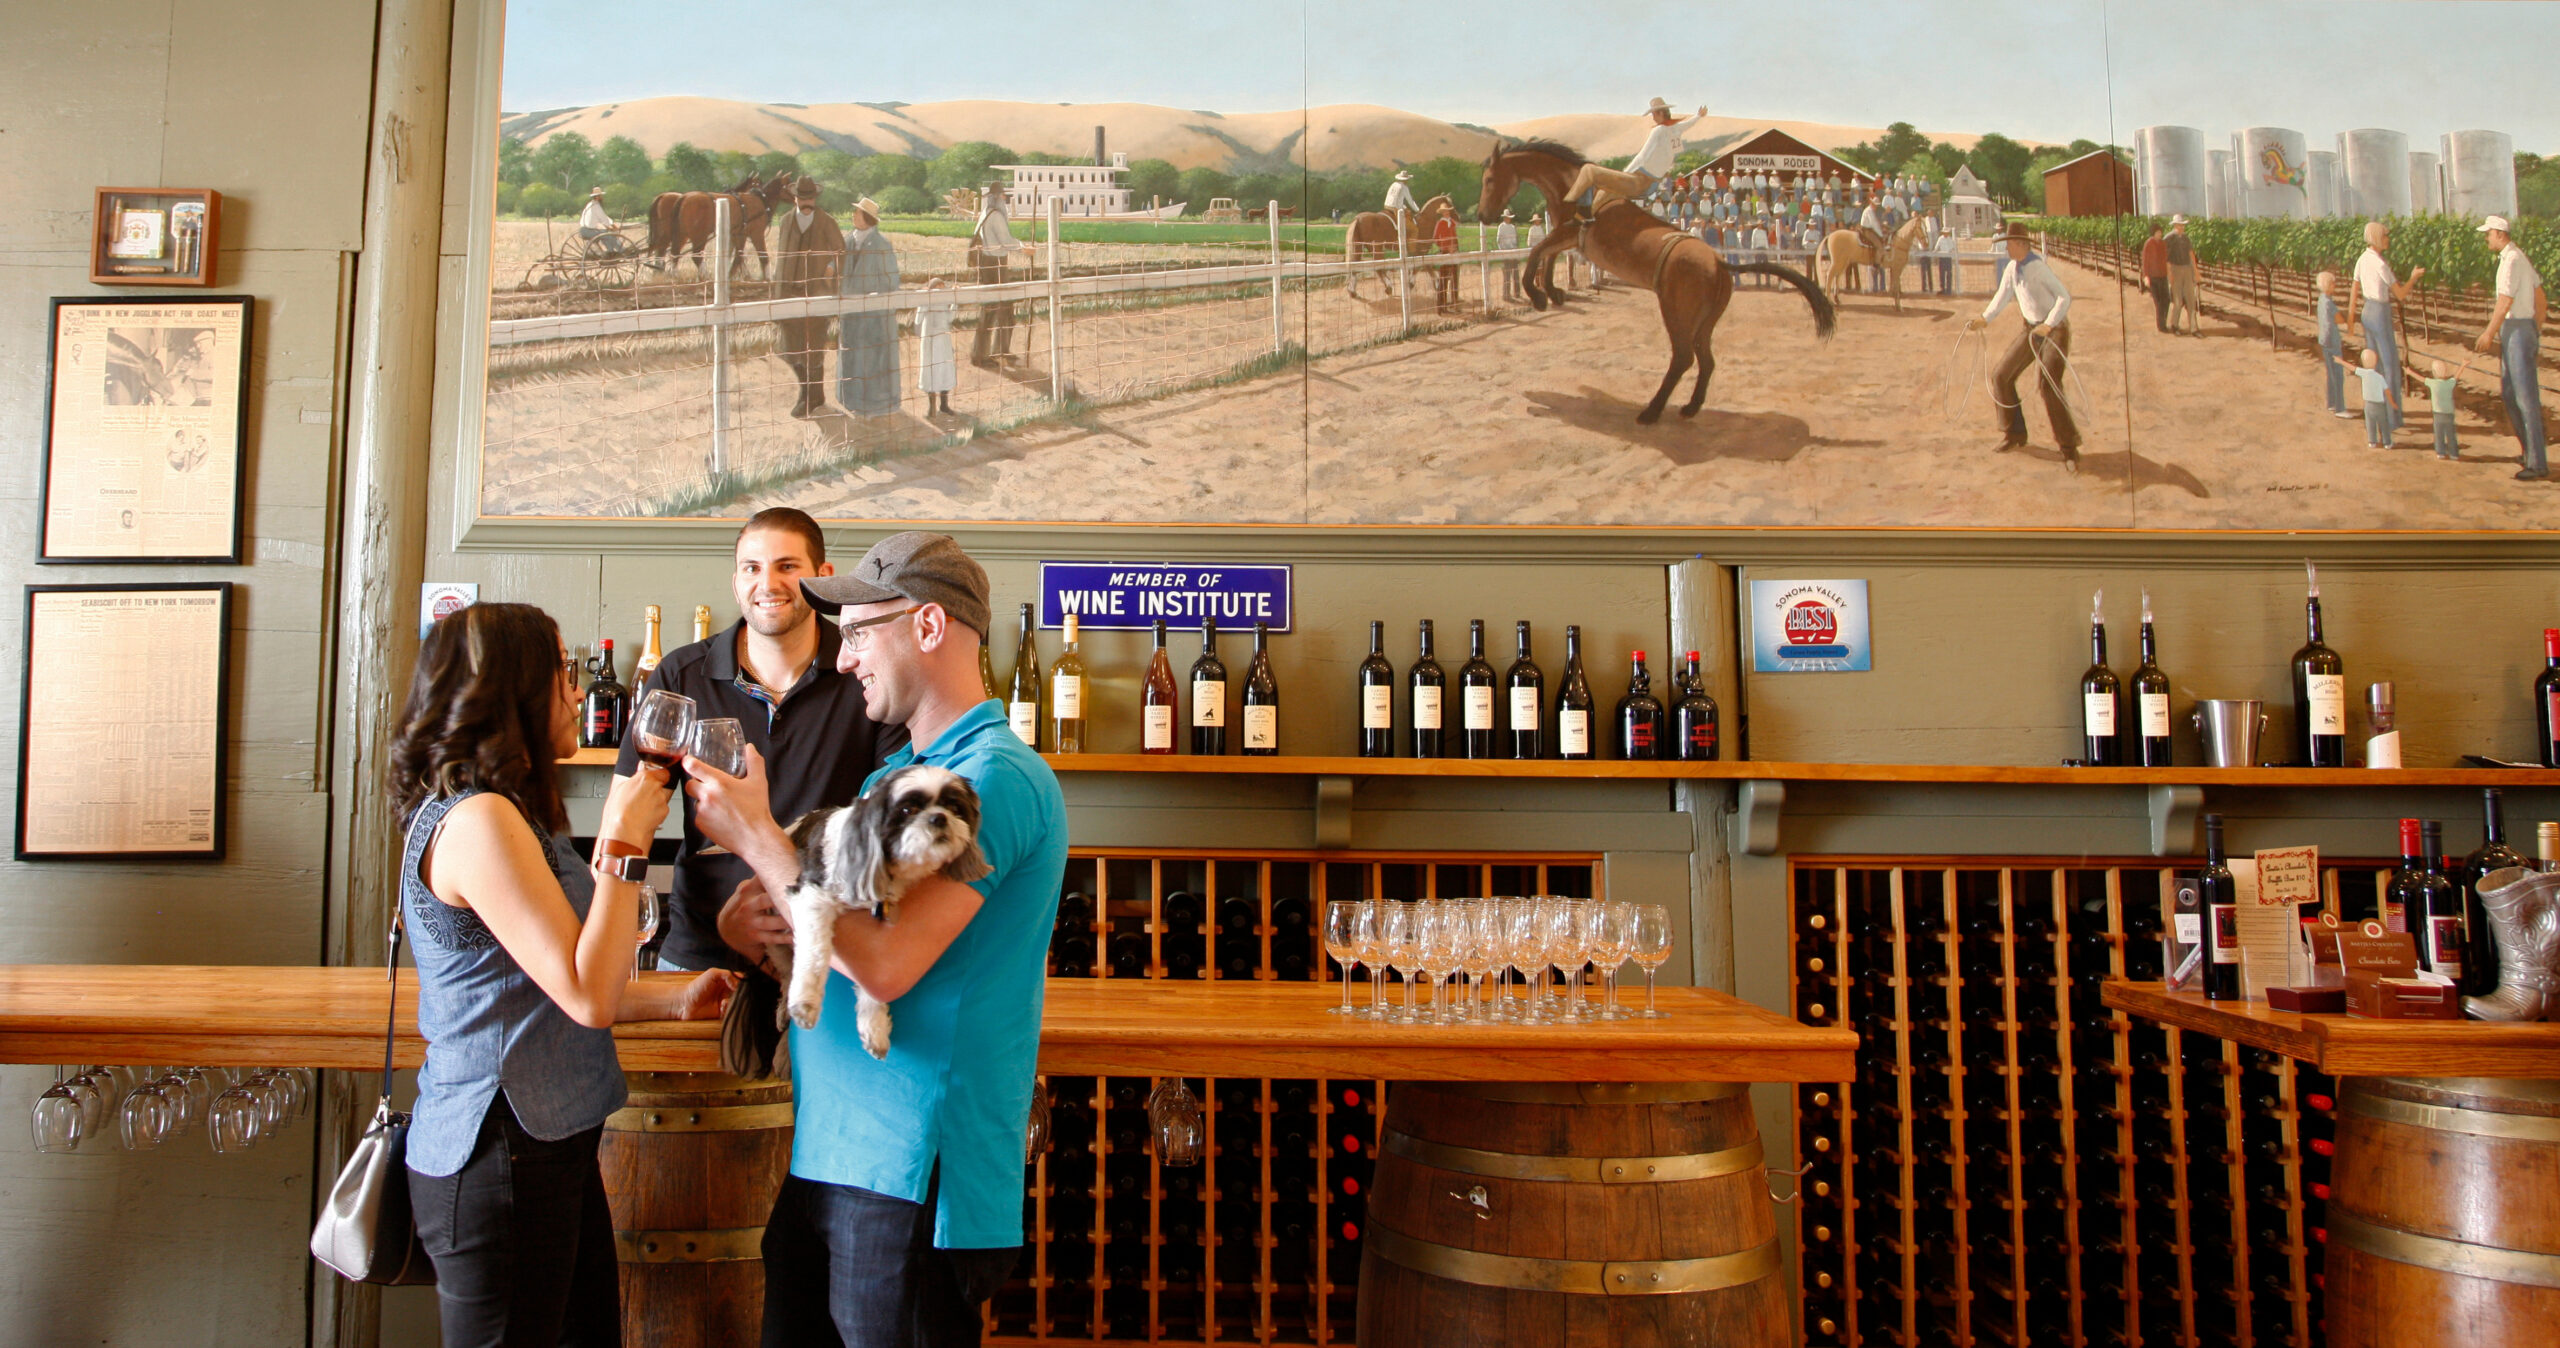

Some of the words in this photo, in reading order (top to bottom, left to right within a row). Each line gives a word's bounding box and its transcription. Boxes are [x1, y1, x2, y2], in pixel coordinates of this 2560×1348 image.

[1737, 157, 1775, 167] SONOMA
[1783, 158, 1815, 168] RODEO
[1108, 573, 1186, 587] MEMBER
[1198, 573, 1222, 588] OF
[145, 598, 159, 606] NEW
[161, 598, 177, 606] YORK
[179, 598, 216, 606] TOMORROW
[1059, 590, 1125, 616] WINE
[1139, 592, 1272, 617] INSTITUTE
[1776, 586, 1812, 609] SONOMA
[1816, 586, 1847, 609] VALLEY
[1788, 605, 1835, 631] BEST
